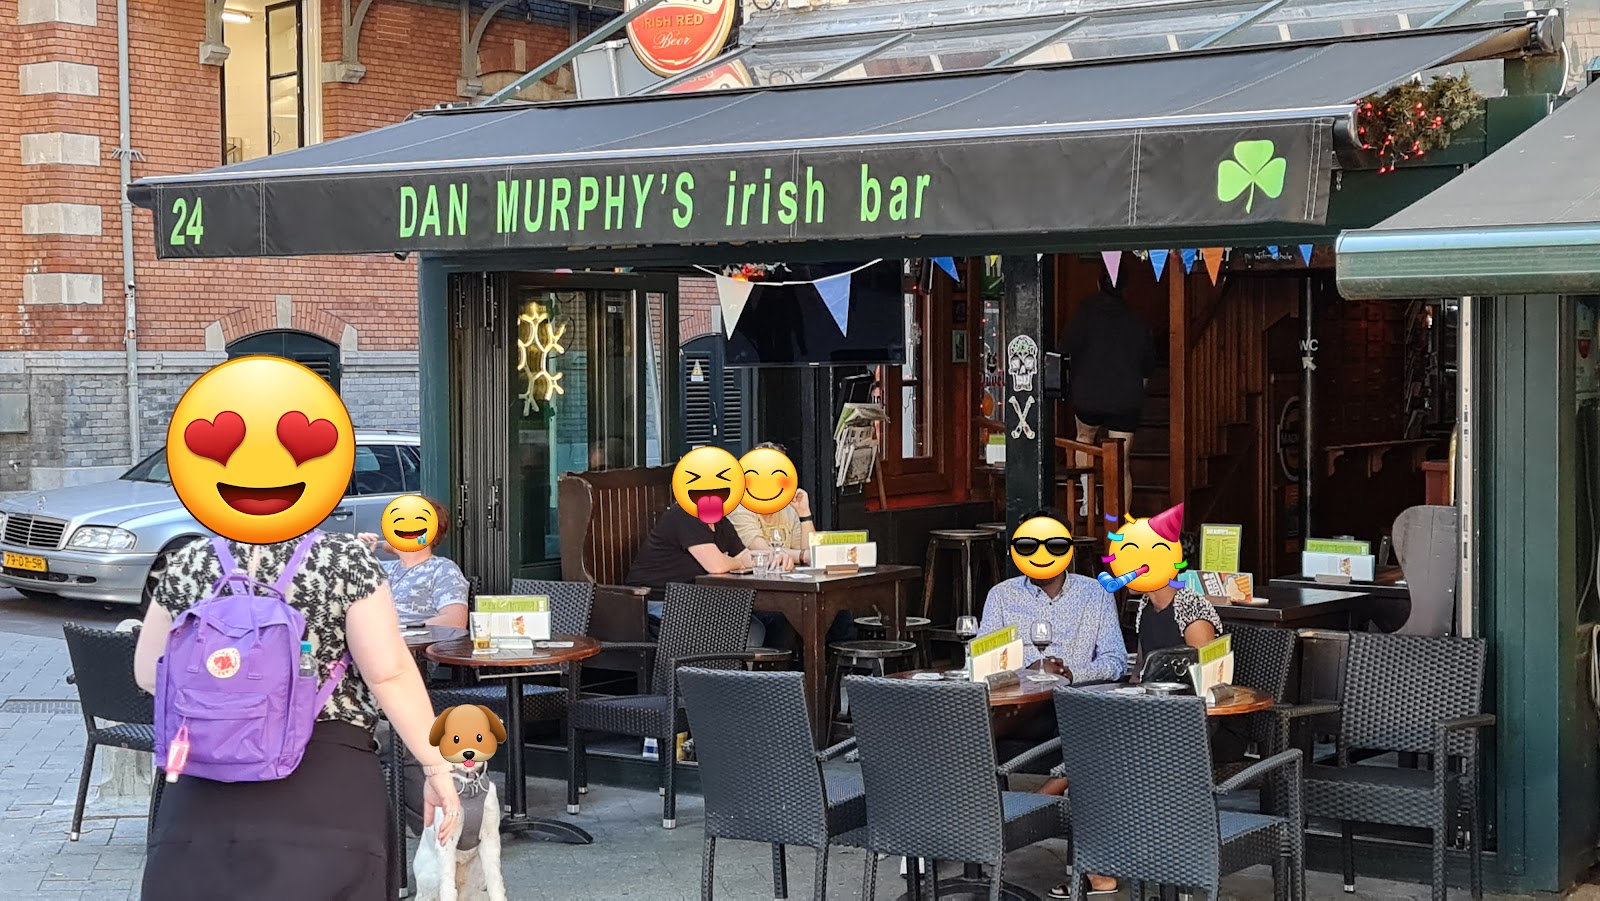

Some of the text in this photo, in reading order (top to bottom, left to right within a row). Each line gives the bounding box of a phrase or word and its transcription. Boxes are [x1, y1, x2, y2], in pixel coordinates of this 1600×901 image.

[642, 14, 704, 29] IRISH RED
[652, 30, 693, 49] Beer
[400, 164, 930, 238] DAN MURPHY'S irish bar
[170, 197, 204, 245] 24
[1299, 339, 1319, 351] WC
